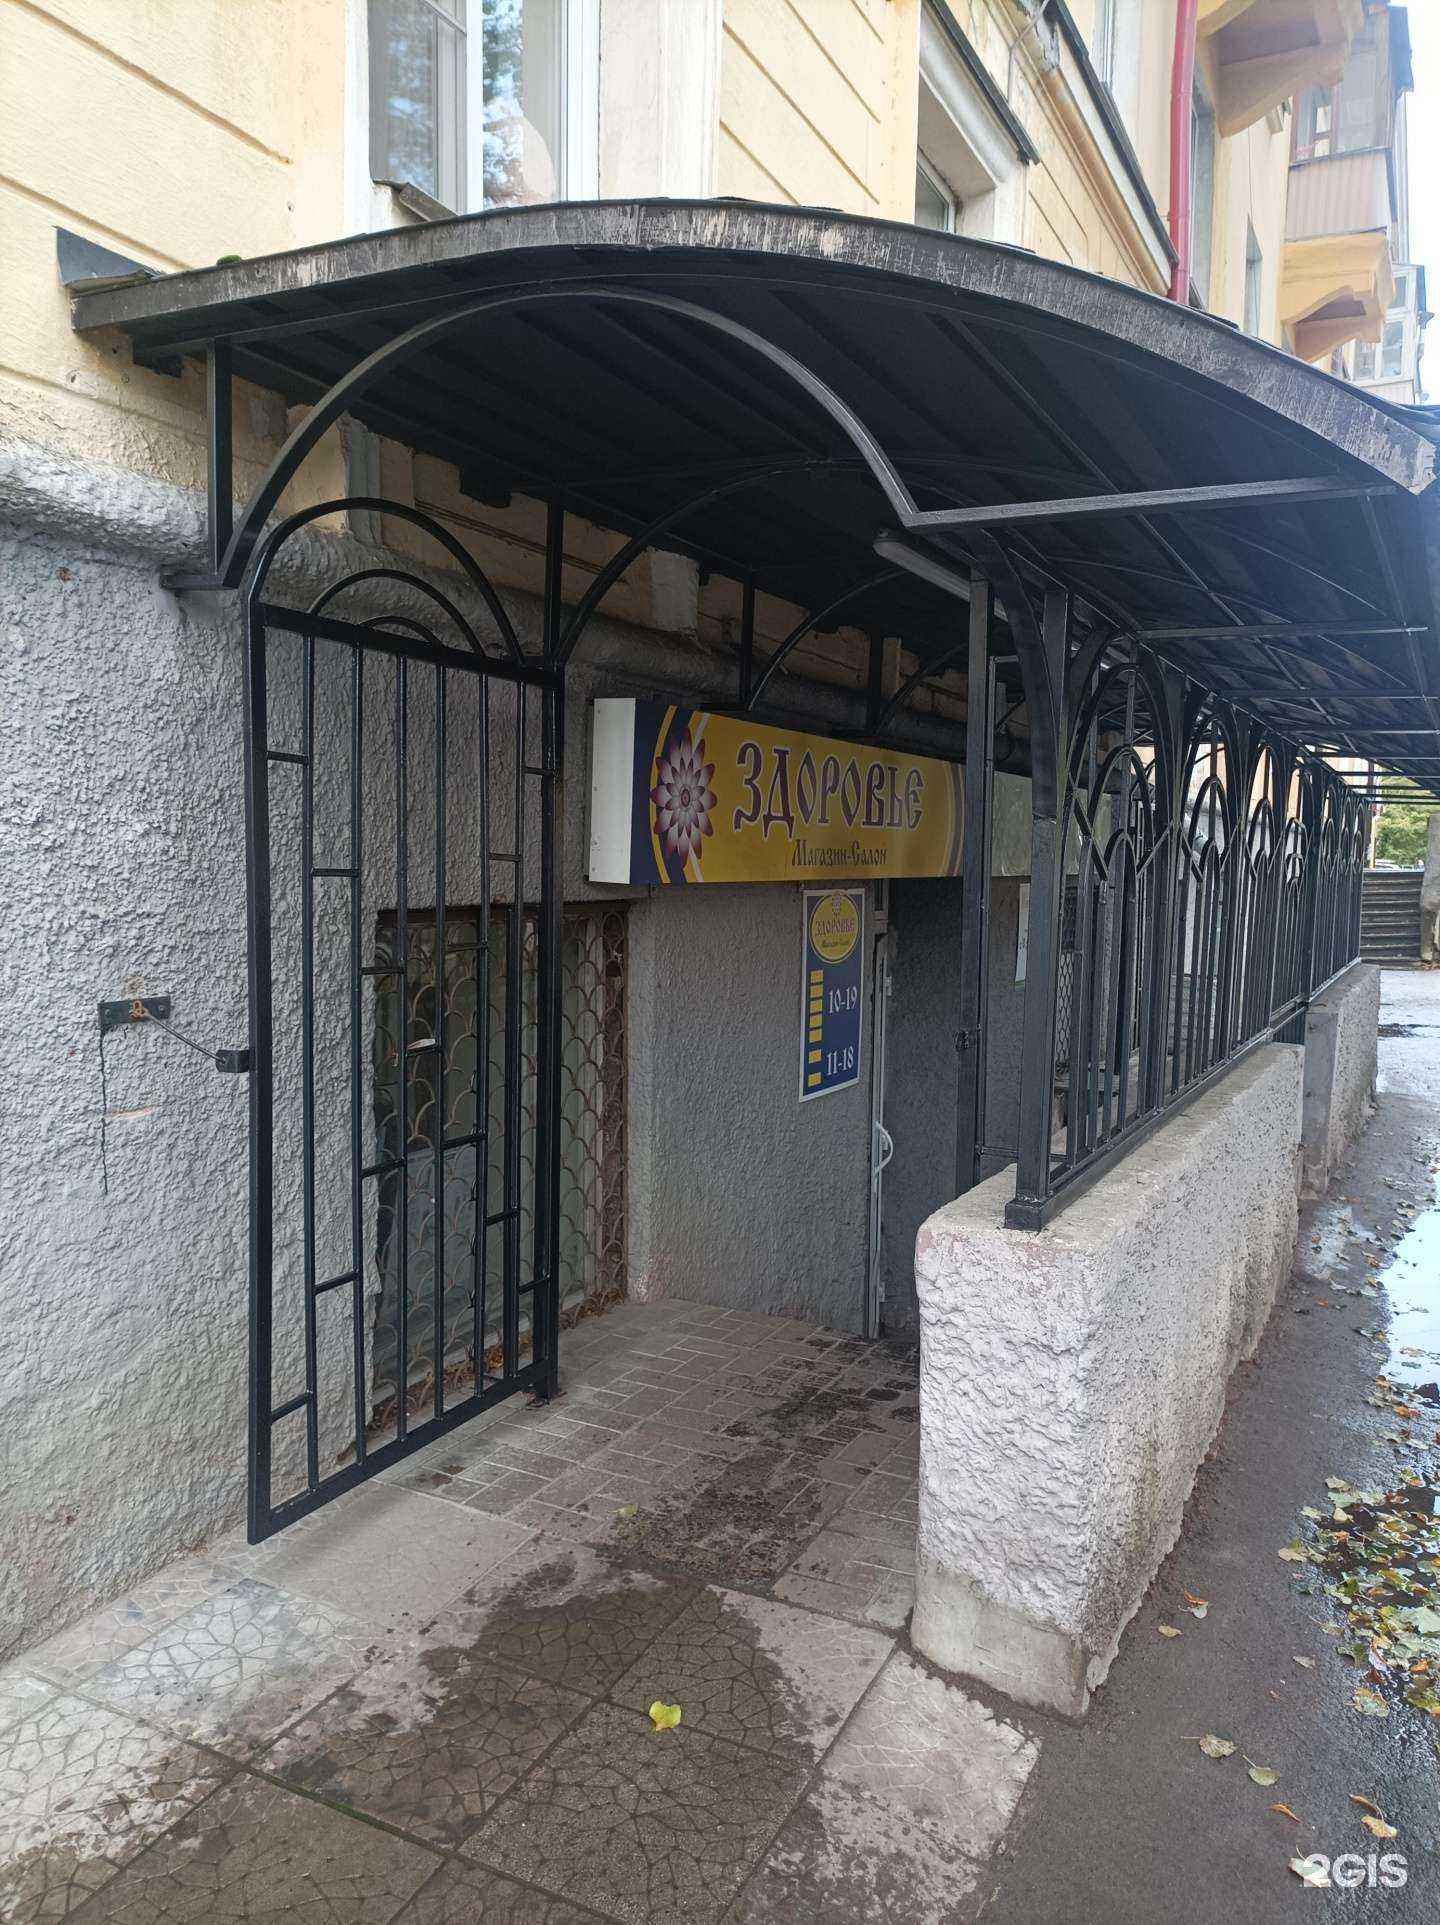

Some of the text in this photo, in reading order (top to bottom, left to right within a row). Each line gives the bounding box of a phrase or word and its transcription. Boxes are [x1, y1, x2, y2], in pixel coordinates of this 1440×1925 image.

[733, 741, 924, 839] ЗДОРОВЬЕ
[829, 986, 858, 1014] 10-19
[826, 1046, 854, 1076] 11-18
